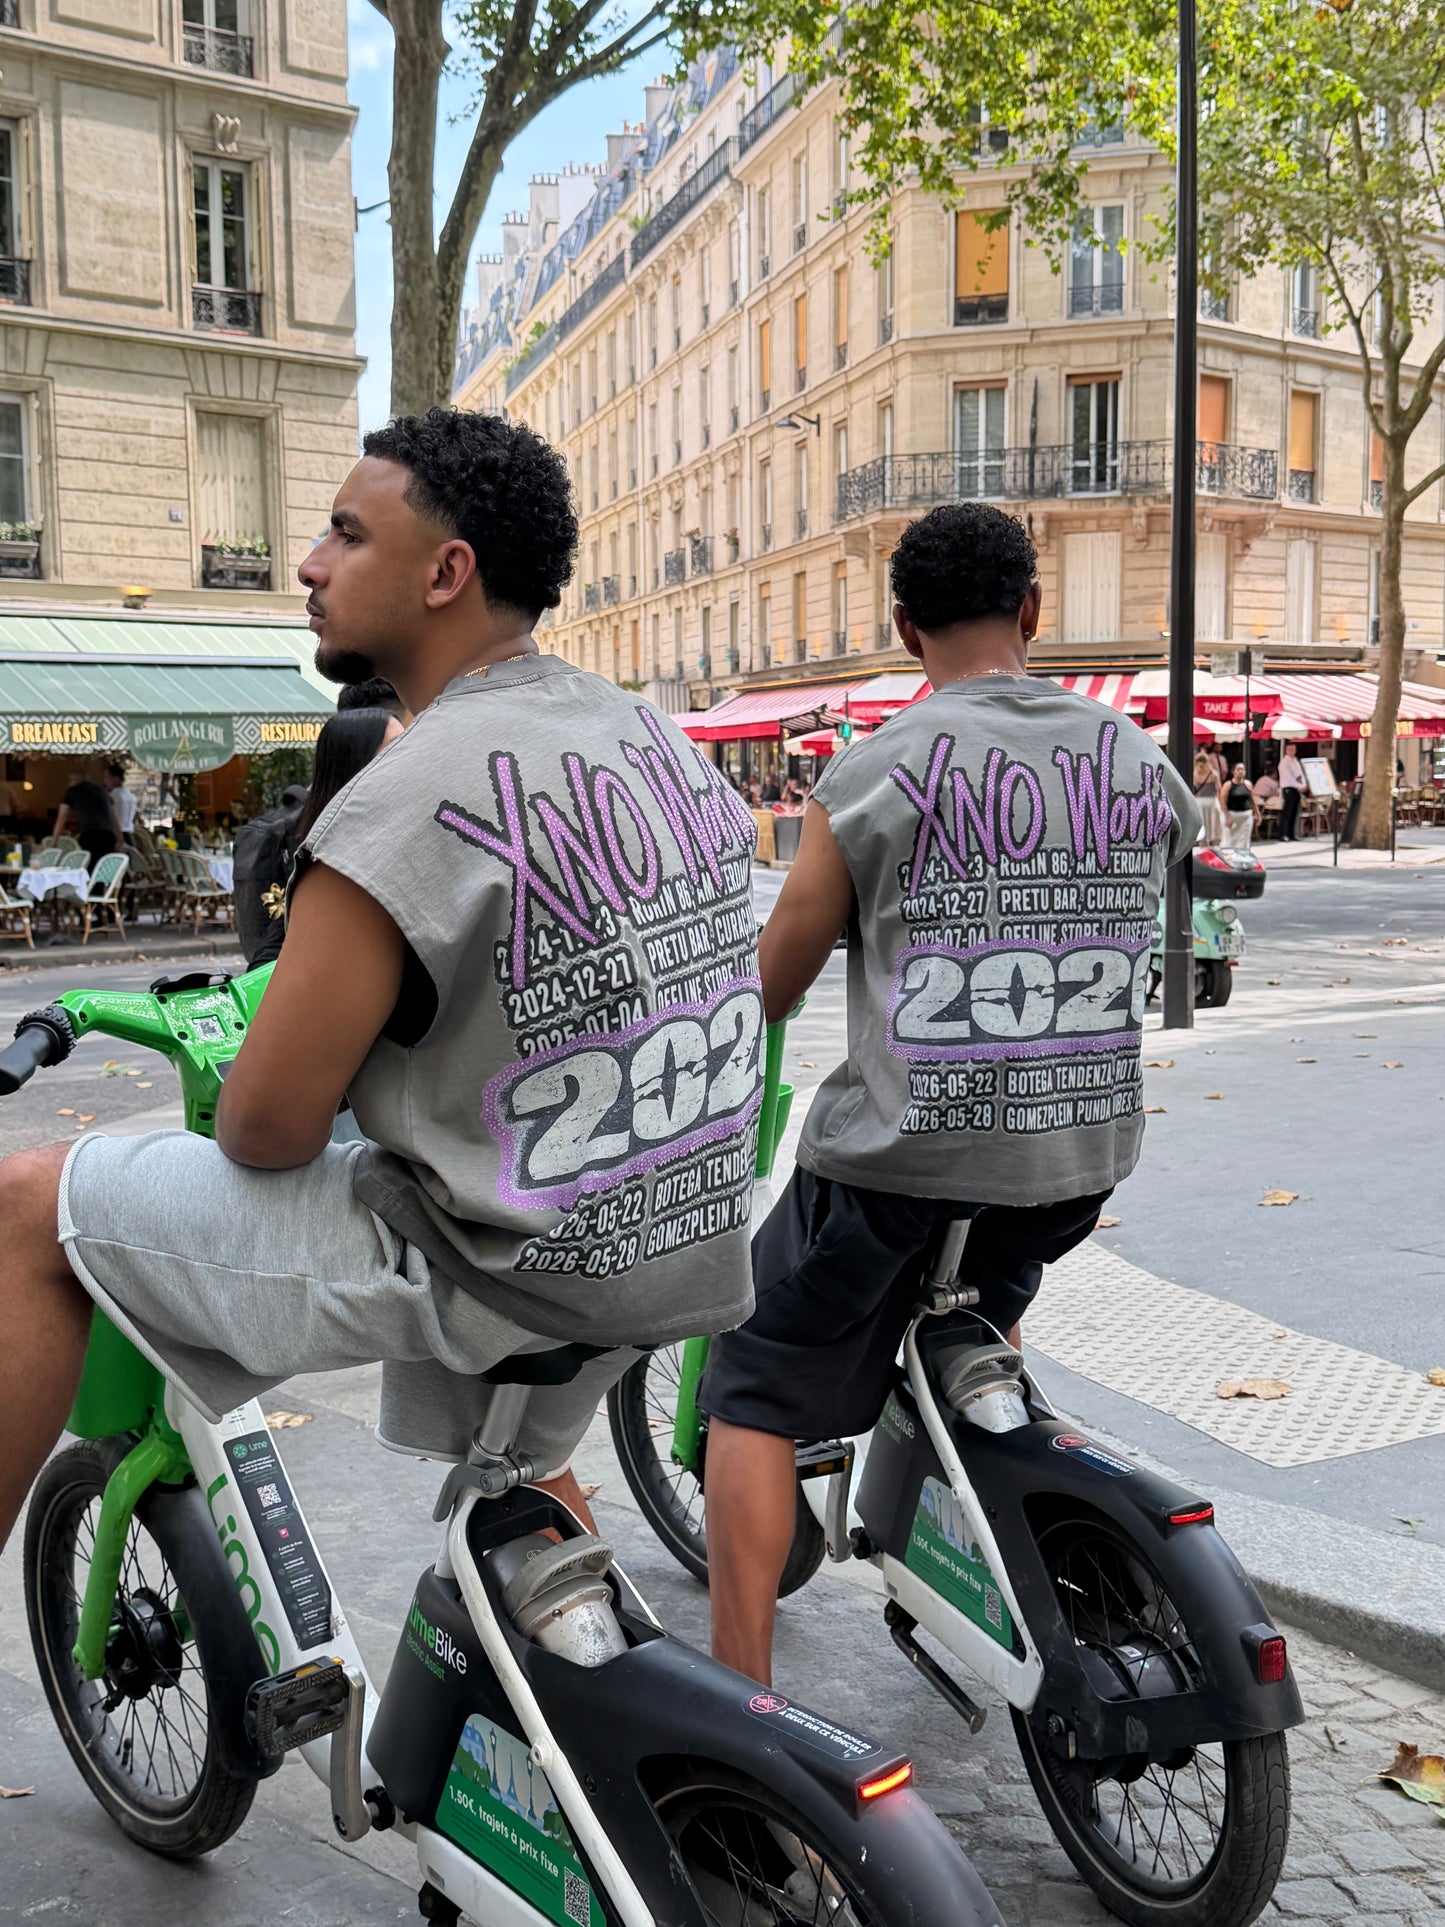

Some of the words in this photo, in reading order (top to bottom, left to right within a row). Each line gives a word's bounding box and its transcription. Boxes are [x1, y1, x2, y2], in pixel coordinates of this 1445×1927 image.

[1203, 702, 1229, 714] TAKE
[11, 723, 98, 743] BREAKFAST
[261, 723, 324, 742] RESTAURA
[891, 736, 1044, 898] XNO
[436, 752, 659, 990] XNO
[902, 890, 985, 920] 2024-12-27
[1001, 888, 1049, 912] PRETU
[1053, 888, 1082, 912] BAR,
[1086, 886, 1144, 914] CURAÇAO
[508, 951, 633, 1025] 2024-12-27
[646, 928, 690, 974] PRETU
[687, 921, 716, 954] BAR,
[512, 992, 767, 1182] 202
[910, 1071, 994, 1098] 2026-05-22
[1007, 1067, 1053, 1095] BOTEGA
[1055, 1062, 1114, 1091] TENDENZA,
[901, 1103, 992, 1132] 2026-05-28
[1006, 1101, 1073, 1130] GOMEZPLEIN
[1076, 1096, 1111, 1124] PUNDA
[654, 1164, 702, 1213] BOTEGA
[520, 1236, 638, 1275] 2026-05-28
[646, 1199, 731, 1255] GOMEZPLEIN
[785, 1712, 806, 1726] DEUX
[803, 1721, 821, 1732] SUR
[818, 1728, 831, 1737] CE
[787, 1706, 836, 1731] INTERDICTION
[832, 1727, 845, 1736] DE
[478, 1805, 509, 1838] trajets
[510, 1828, 518, 1846] à
[519, 1838, 538, 1862] prix
[540, 1850, 559, 1878] fixe
